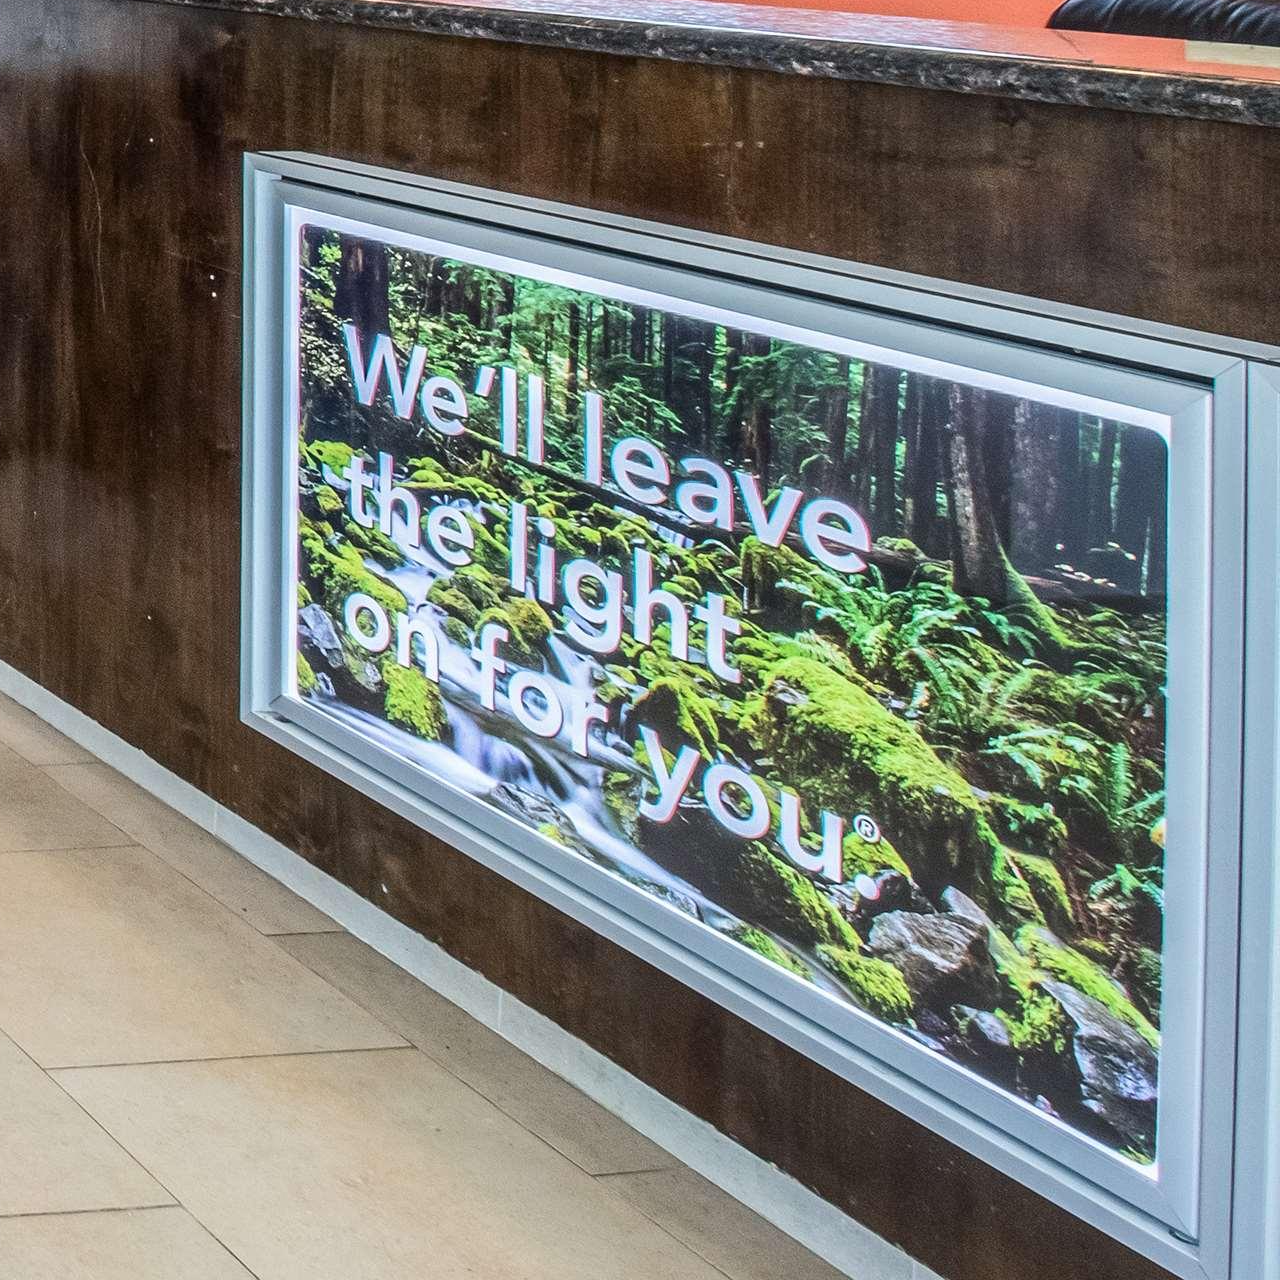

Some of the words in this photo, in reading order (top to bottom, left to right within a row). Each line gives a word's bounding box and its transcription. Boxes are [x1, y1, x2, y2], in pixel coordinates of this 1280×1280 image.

[342, 323, 544, 466] We'll
[584, 391, 872, 574] leave
[343, 451, 474, 567] the
[510, 501, 741, 684] light
[344, 591, 439, 683] on
[472, 622, 609, 758] for
